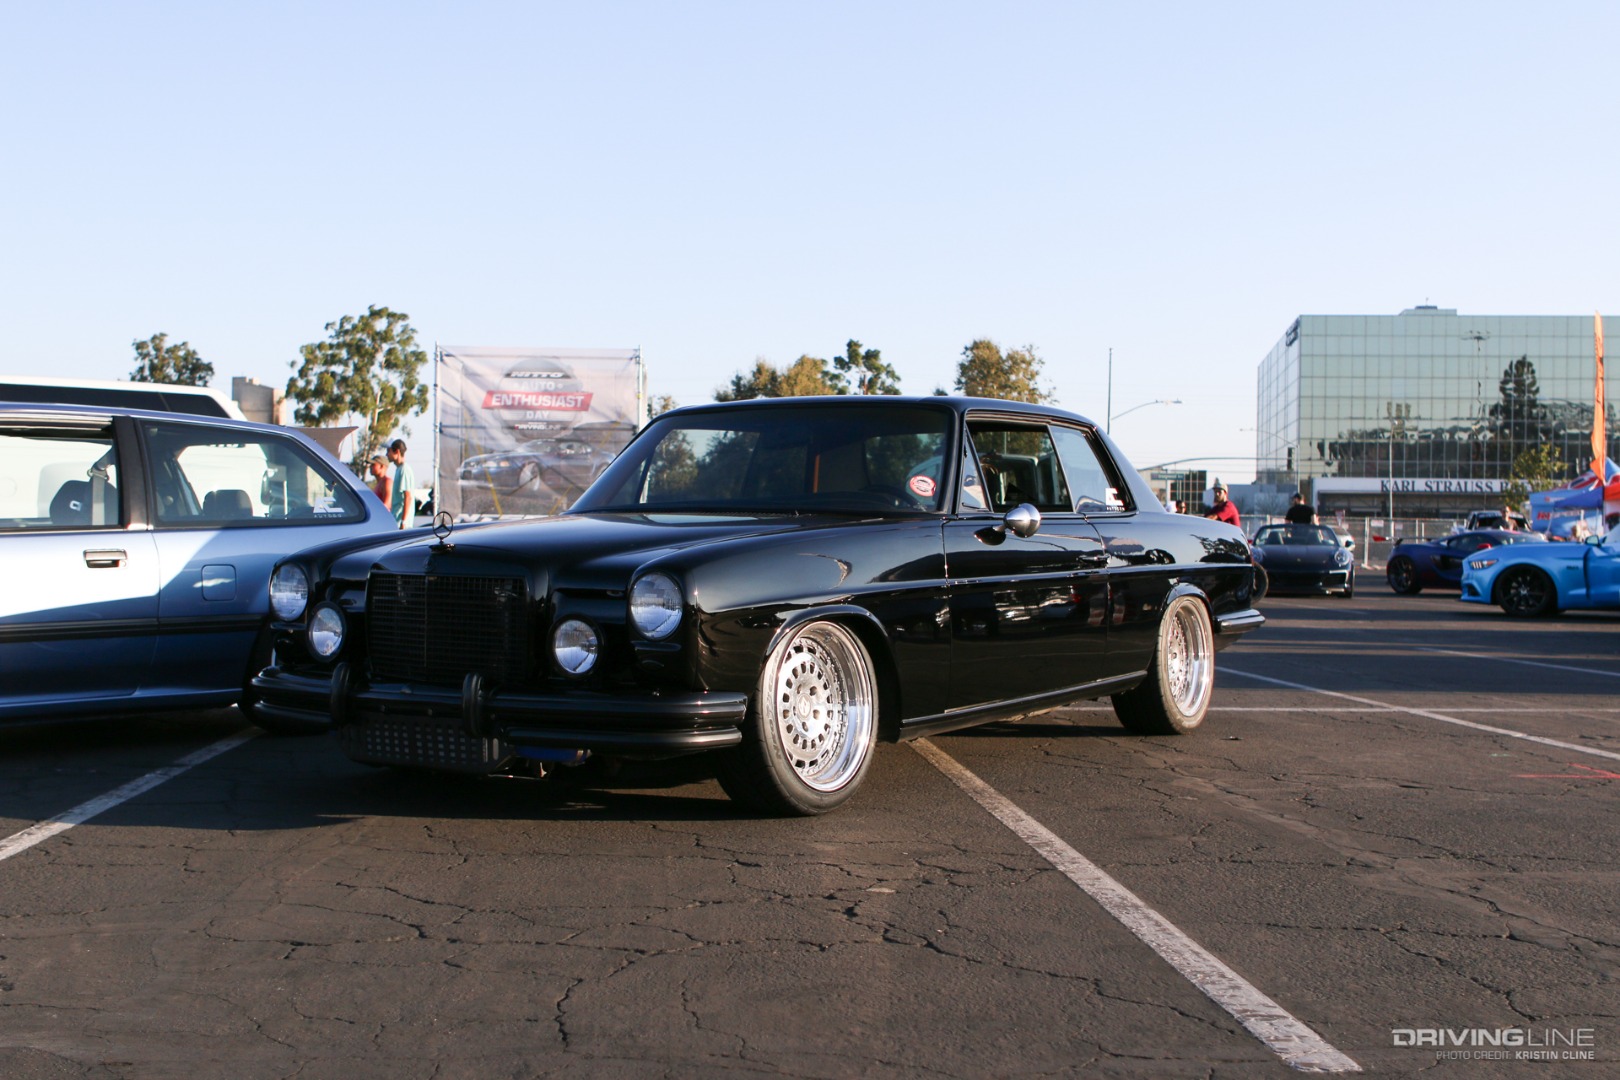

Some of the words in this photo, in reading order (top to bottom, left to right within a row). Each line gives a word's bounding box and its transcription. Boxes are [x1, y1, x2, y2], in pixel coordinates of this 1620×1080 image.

[521, 381, 555, 390] AUTO
[491, 394, 584, 408] ENTHUSIAST
[526, 411, 550, 420] DAY
[1380, 480, 1419, 493] KARL
[1425, 480, 1493, 493] STRAUSS
